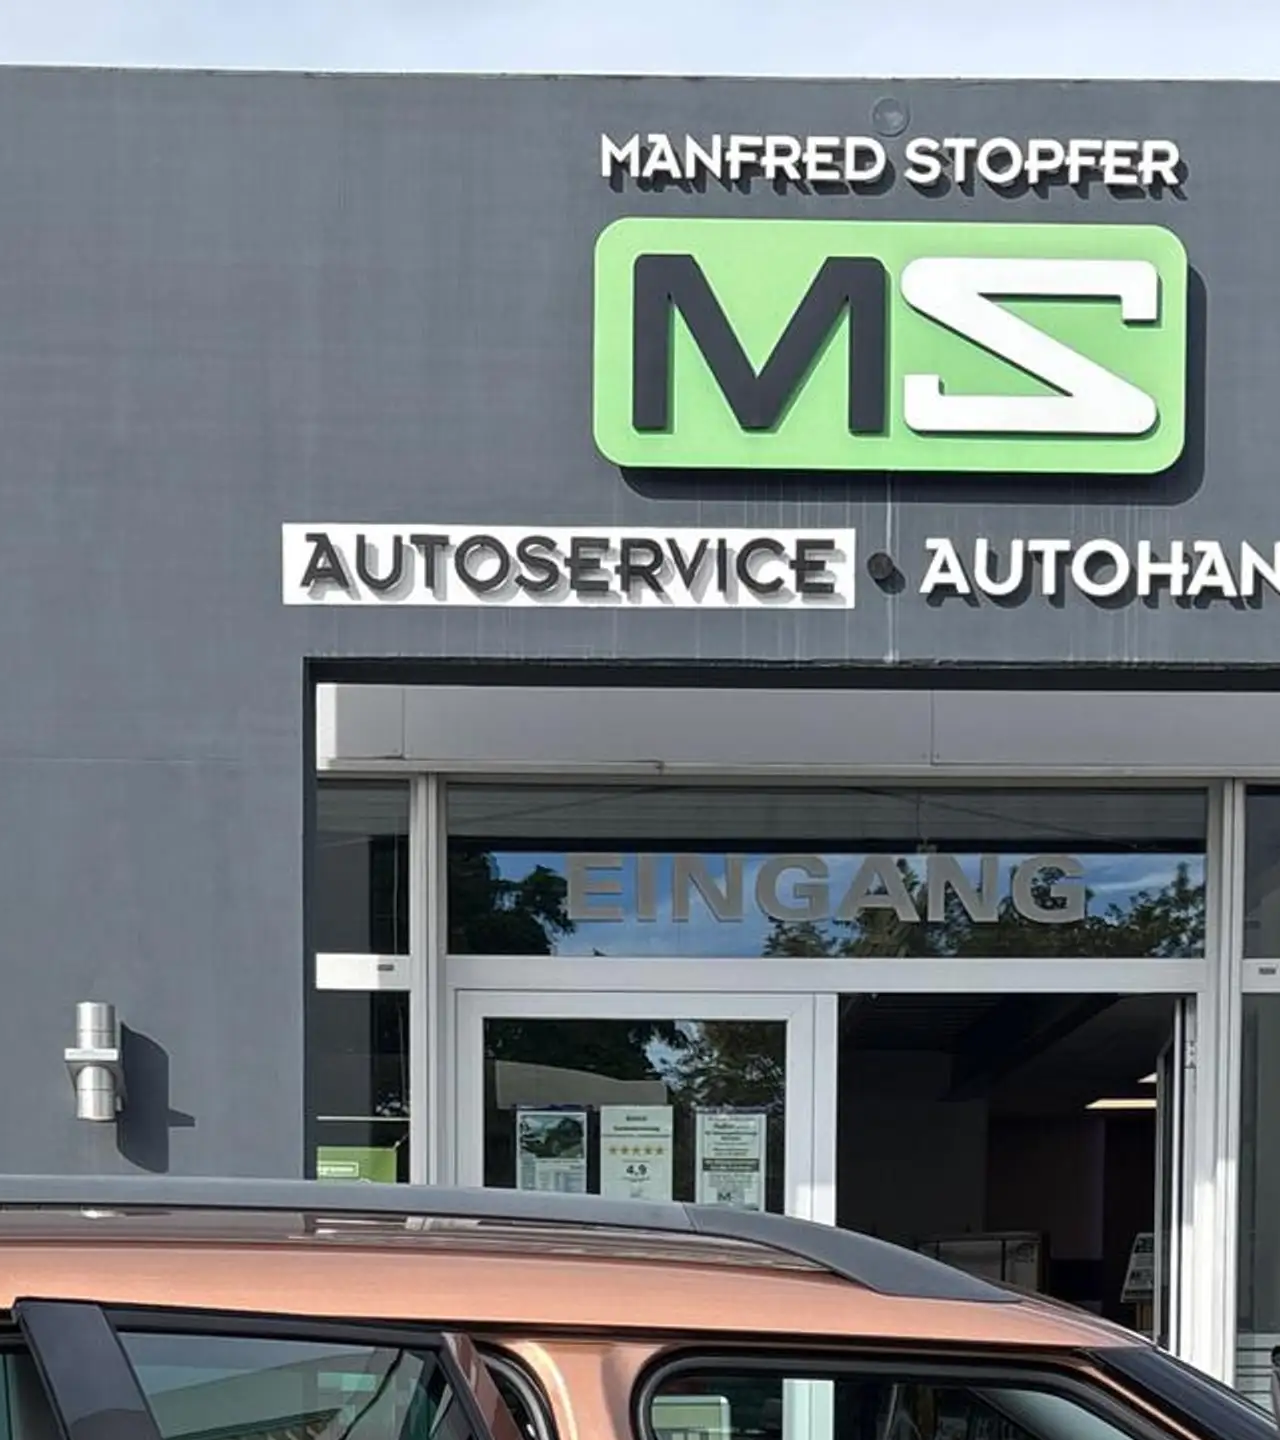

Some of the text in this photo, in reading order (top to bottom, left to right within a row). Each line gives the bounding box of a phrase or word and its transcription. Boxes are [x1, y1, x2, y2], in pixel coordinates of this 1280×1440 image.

[601, 132, 1180, 187] MANFRED STOPFER
[300, 533, 836, 594] AUTOSERVICE
[566, 852, 1086, 923] EINGANG
